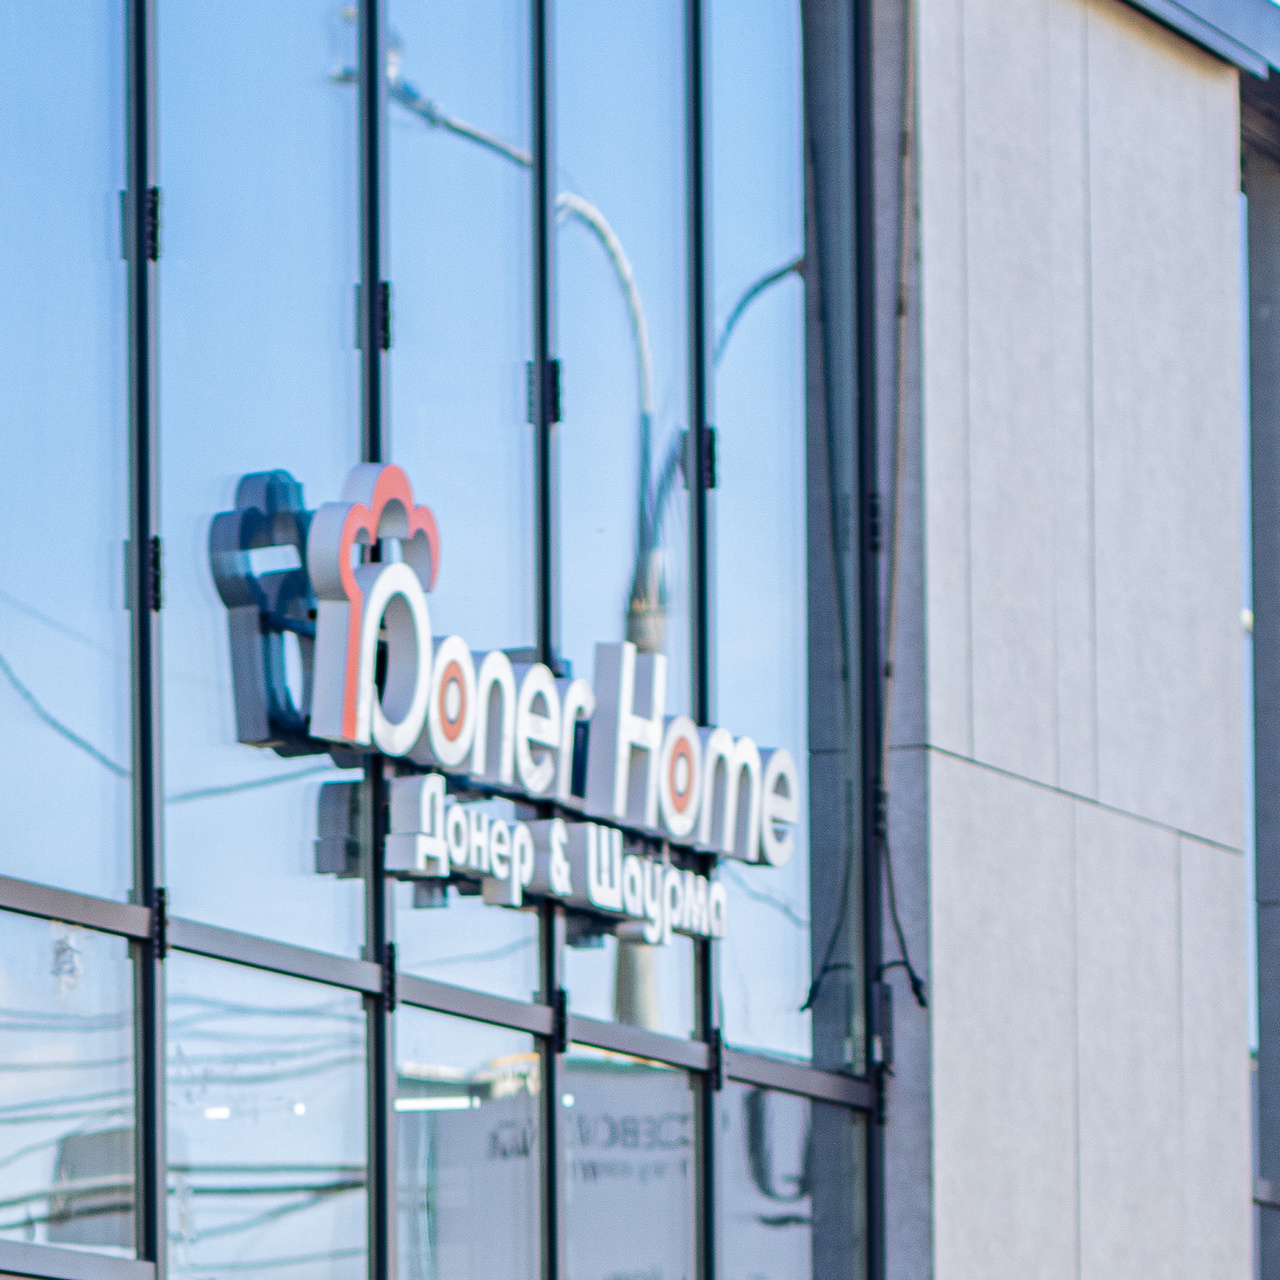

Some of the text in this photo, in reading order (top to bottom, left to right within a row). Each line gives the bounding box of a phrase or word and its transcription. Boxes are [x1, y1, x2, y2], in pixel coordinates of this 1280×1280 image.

[357, 561, 800, 868] Doner Home
[415, 773, 728, 945] Донер & Шаурма
